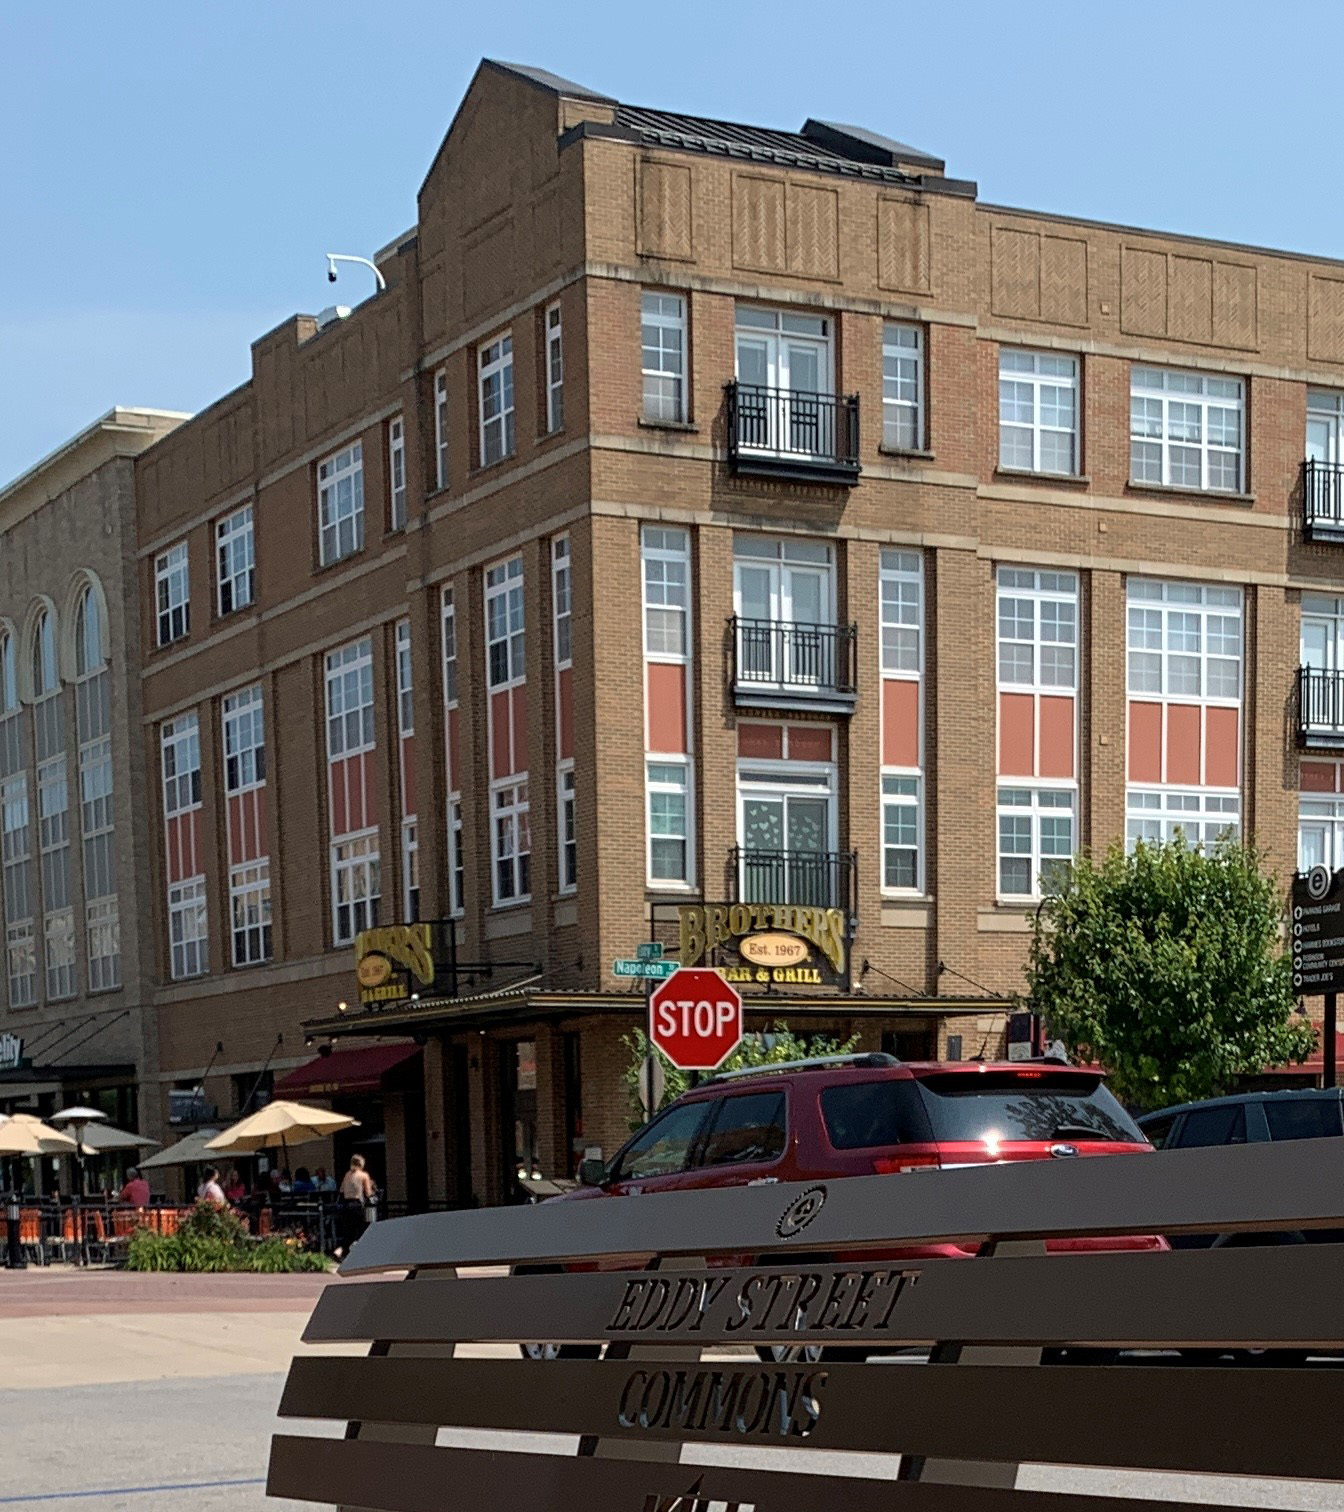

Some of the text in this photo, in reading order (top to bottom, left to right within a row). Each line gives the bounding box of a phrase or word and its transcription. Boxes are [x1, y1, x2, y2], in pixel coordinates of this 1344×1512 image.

[678, 903, 845, 974] BROTHERS
[748, 942, 801, 958] Est. 1967
[616, 961, 663, 976] Napoleon
[718, 967, 822, 983] BAR & GRILL
[657, 1000, 736, 1038] STOP
[606, 1269, 923, 1332] EDDY STREET
[617, 1369, 829, 1437] COMMONS
